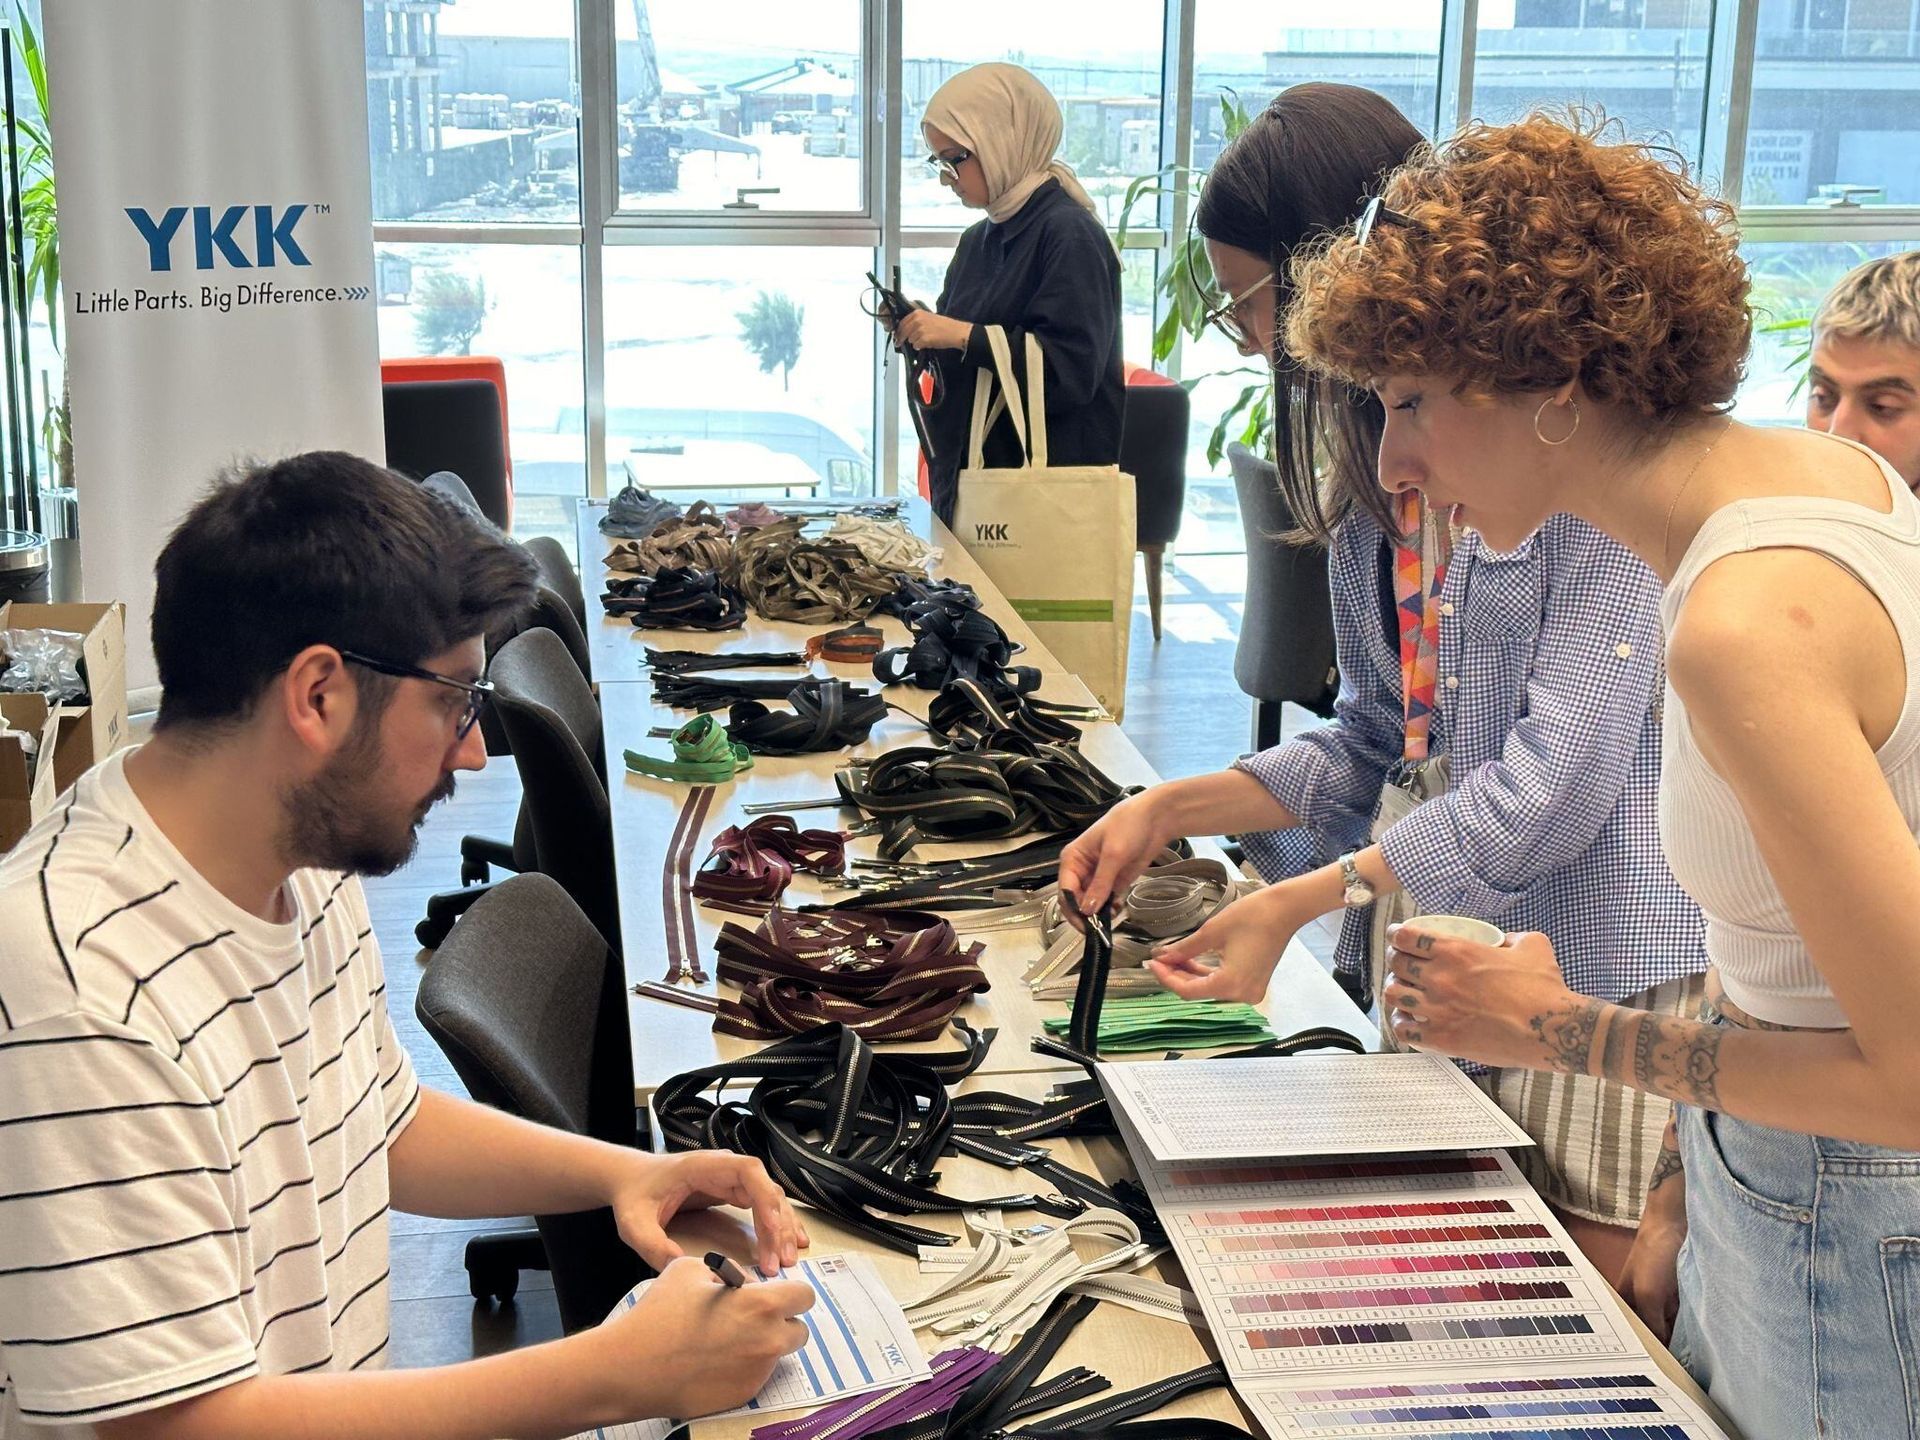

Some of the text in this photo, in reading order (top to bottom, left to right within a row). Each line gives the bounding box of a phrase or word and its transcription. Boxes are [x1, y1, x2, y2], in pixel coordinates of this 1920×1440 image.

[124, 205, 312, 272] YKK
[75, 282, 342, 314] Little Parts. Big Difference.
[975, 523, 1008, 541] YKK
[884, 1343, 903, 1366] YKK
